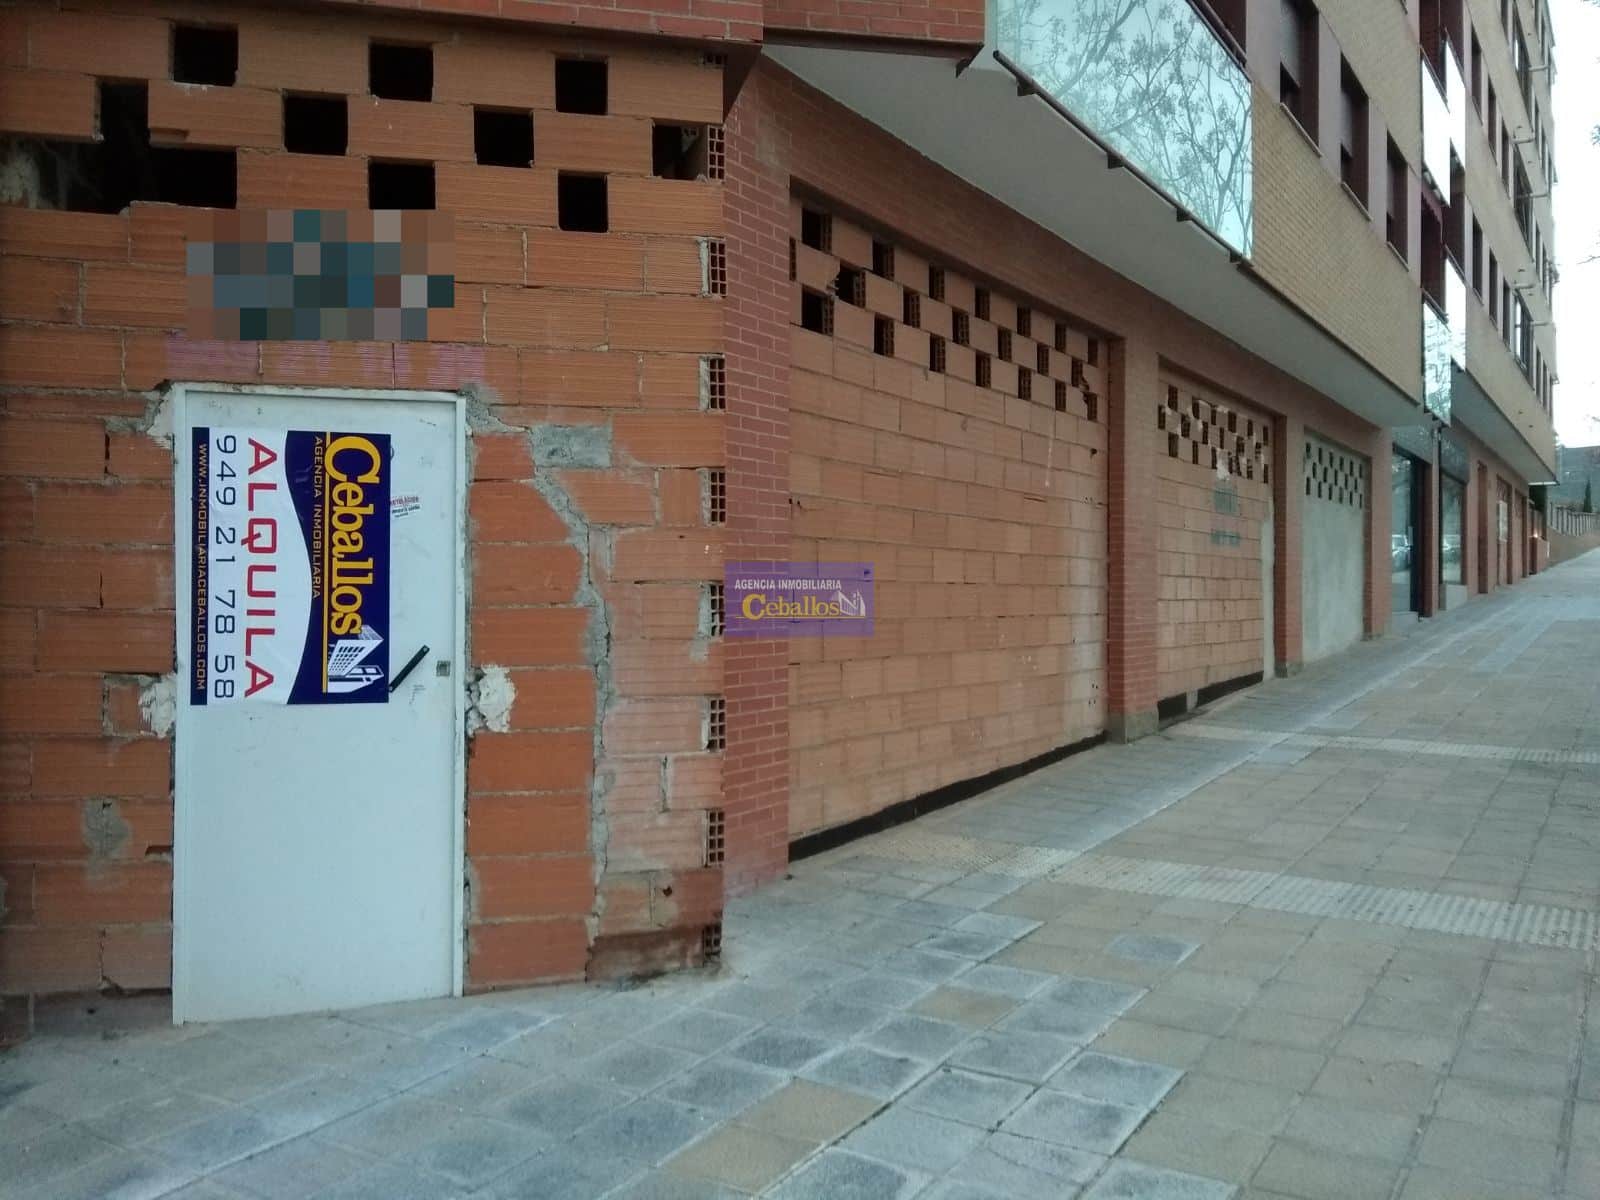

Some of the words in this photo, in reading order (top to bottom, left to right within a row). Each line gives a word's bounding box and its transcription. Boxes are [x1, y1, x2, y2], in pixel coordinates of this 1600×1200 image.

[215, 435, 237, 506] 949
[313, 436, 323, 498] AGENCIA
[215, 526, 236, 563] 21
[240, 437, 278, 698] ALQUILA
[312, 504, 323, 600] INMOBILIARIA
[324, 435, 382, 636] Ceballos
[214, 589, 236, 635] 78
[214, 655, 235, 699] 58
